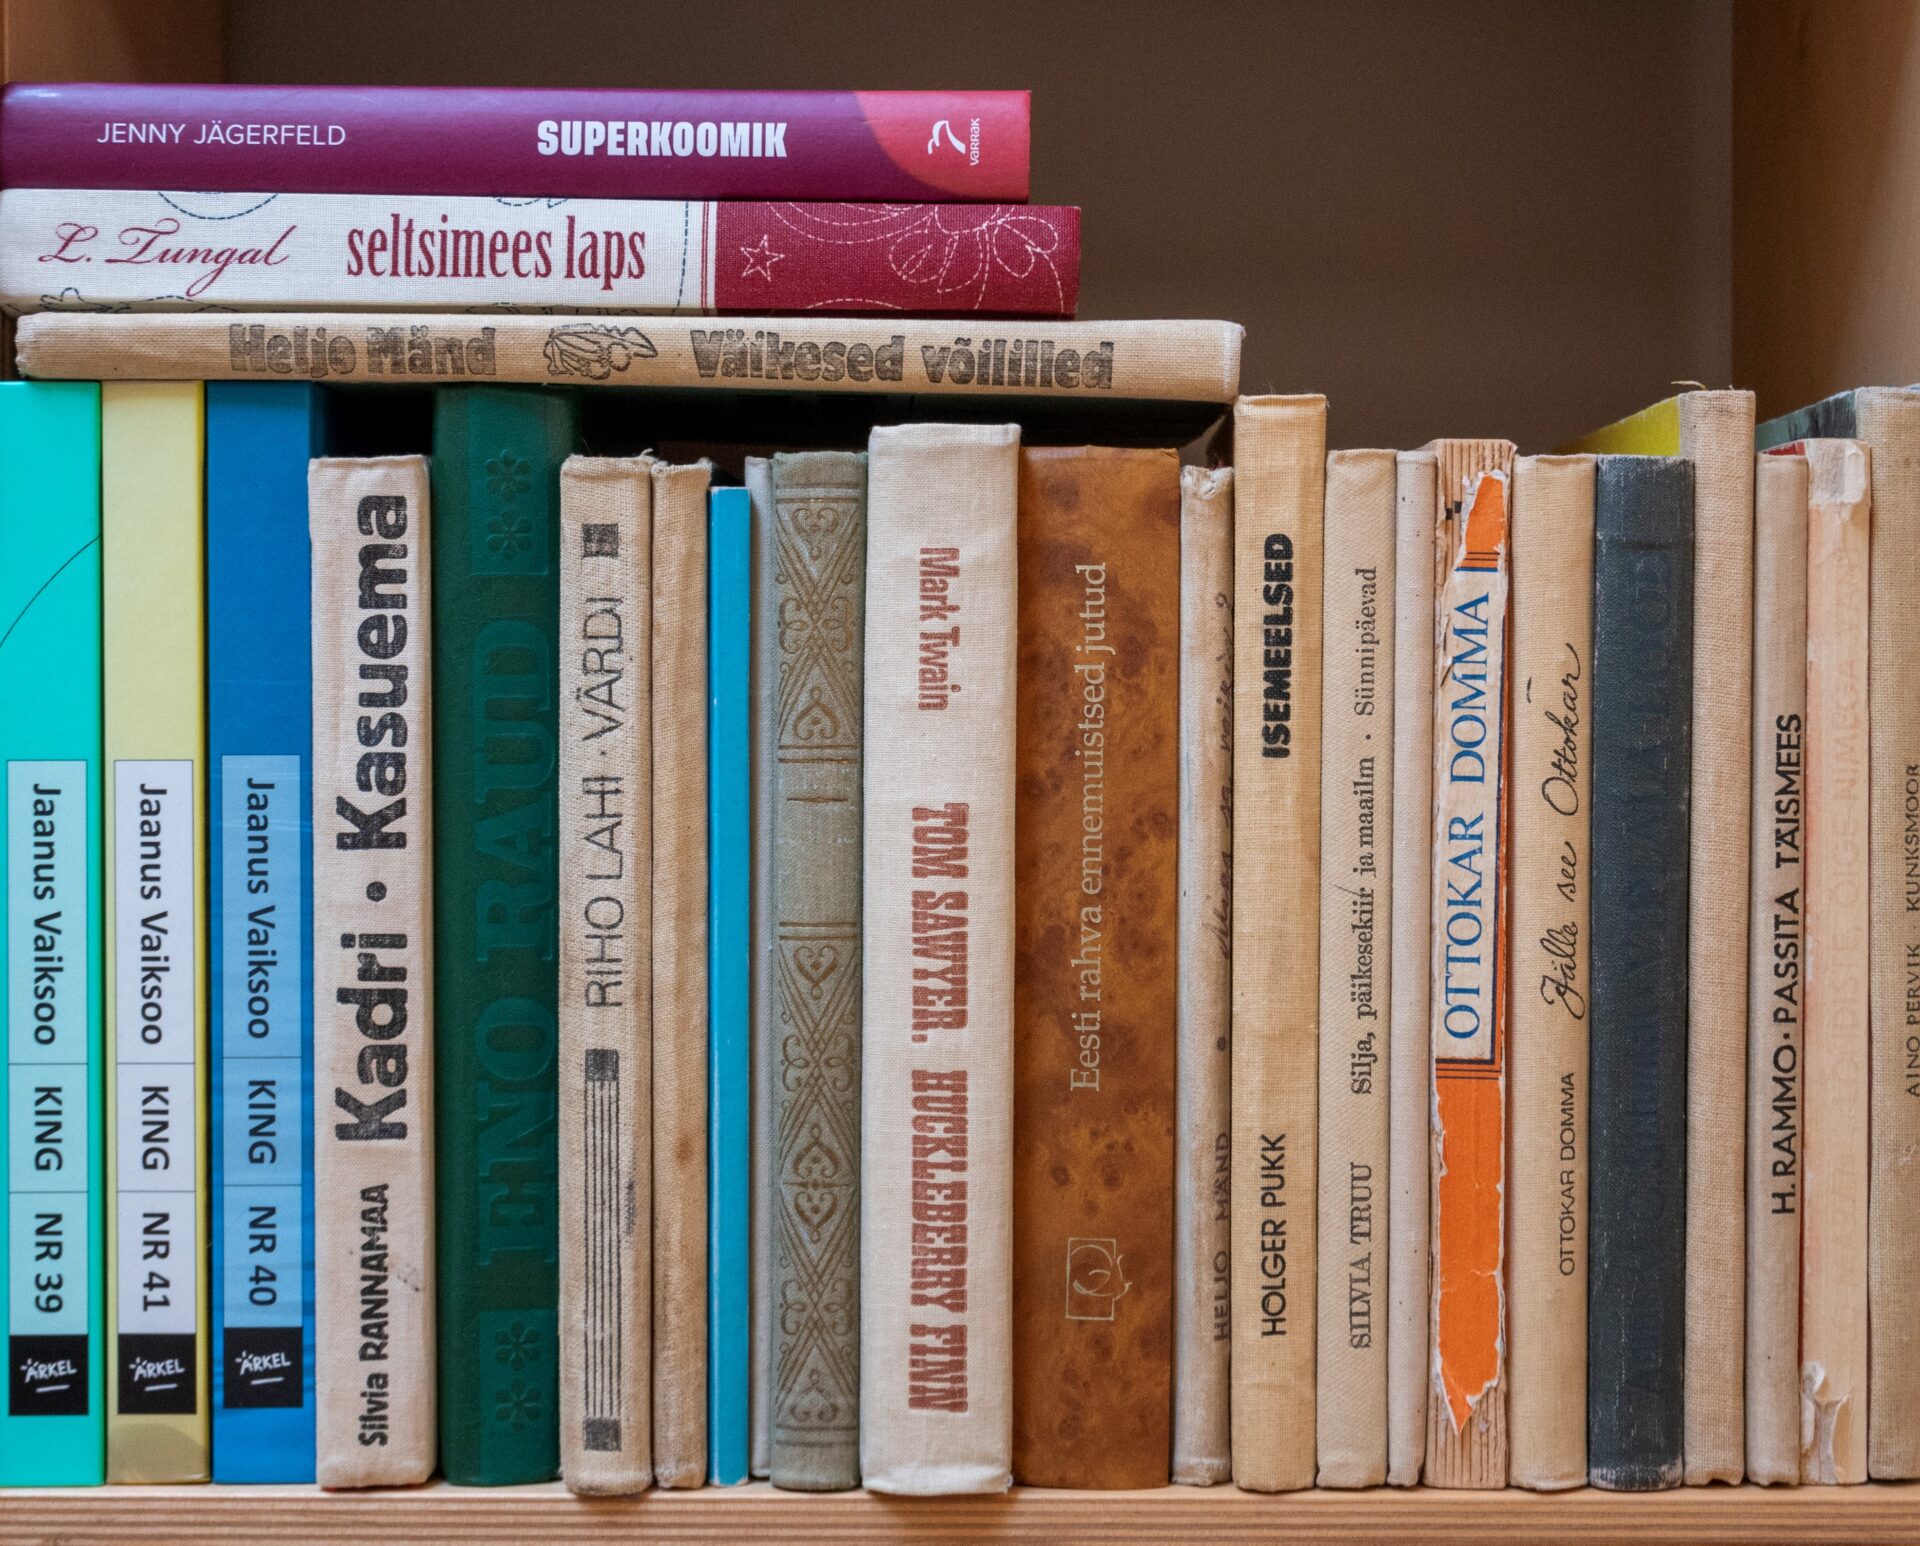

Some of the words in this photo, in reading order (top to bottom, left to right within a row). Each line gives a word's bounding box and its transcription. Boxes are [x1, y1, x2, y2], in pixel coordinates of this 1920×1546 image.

[96, 118, 188, 146] JENNY
[193, 116, 347, 147] JÄGERFELD
[536, 118, 788, 159] SUPERKOOMIK
[104, 217, 298, 298] Tungal
[346, 212, 553, 279] seltsimees
[565, 214, 647, 290] laps
[229, 323, 357, 378] Heljo
[368, 325, 496, 376] Mänd
[690, 328, 904, 379] Väikesed
[920, 336, 1114, 389] võililled
[918, 547, 962, 624] Mark
[1075, 562, 1116, 656] jutud
[334, 493, 409, 852] Kasuema
[576, 597, 625, 742] VÄRDI
[917, 625, 962, 712] Twain
[1262, 533, 1294, 760] ISEMEELSED
[1353, 566, 1379, 717] Sünnipäevad
[1449, 591, 1490, 787] DOMMA
[1540, 643, 1582, 818] Ottokar
[1073, 660, 1107, 896] ennemuistsed
[1352, 756, 1375, 848] maailm
[1775, 713, 1802, 869] TÄISMEES
[33, 783, 62, 901] Jaanus
[139, 783, 168, 901] Jaanus
[247, 777, 275, 895] Jaanus
[911, 802, 970, 880] TOM
[1352, 853, 1377, 879] ja
[1557, 841, 1580, 904] see
[1904, 763, 1920, 913] KUNKSMOOR
[247, 904, 278, 1040] Vaiksoo
[585, 895, 626, 1009] RIHO
[910, 890, 970, 1044] SAWYER.
[1070, 904, 1104, 1003] rahva
[1350, 887, 1378, 1021] päikesekiir
[1443, 812, 1487, 1041] OTTOKAR
[1773, 887, 1800, 1025] PASSITA
[33, 910, 64, 1046] Vaiksoo
[140, 910, 170, 1046] Vaiksoo
[1905, 943, 1920, 1026] PERVIK
[334, 933, 409, 1142] Kadri
[1069, 1010, 1102, 1093] Eesti
[1350, 1030, 1378, 1096] Silja,
[1905, 1035, 1920, 1098] AINO
[34, 1086, 64, 1172] KING
[141, 1085, 171, 1172] KING
[248, 1079, 278, 1166] KING
[1558, 1071, 1577, 1162] DOMMA
[1771, 1043, 1798, 1215] H.RAMMO
[910, 1068, 970, 1314] HUCKLEBERRY
[1260, 1132, 1288, 1210] PUKK
[1349, 1160, 1374, 1246] TRUU
[34, 1212, 64, 1263] NR
[141, 1210, 171, 1264] NR
[248, 1204, 278, 1257] NR
[1558, 1168, 1577, 1278] OTTOKAR
[34, 1271, 64, 1314] 39
[141, 1271, 171, 1313] 41
[248, 1263, 278, 1307] 40
[357, 1183, 390, 1362] RANNAMAA
[1261, 1217, 1287, 1340] HOLGER
[1349, 1252, 1373, 1352] SILVIA
[357, 1371, 389, 1446] Silvia
[907, 1322, 970, 1414] FINN
